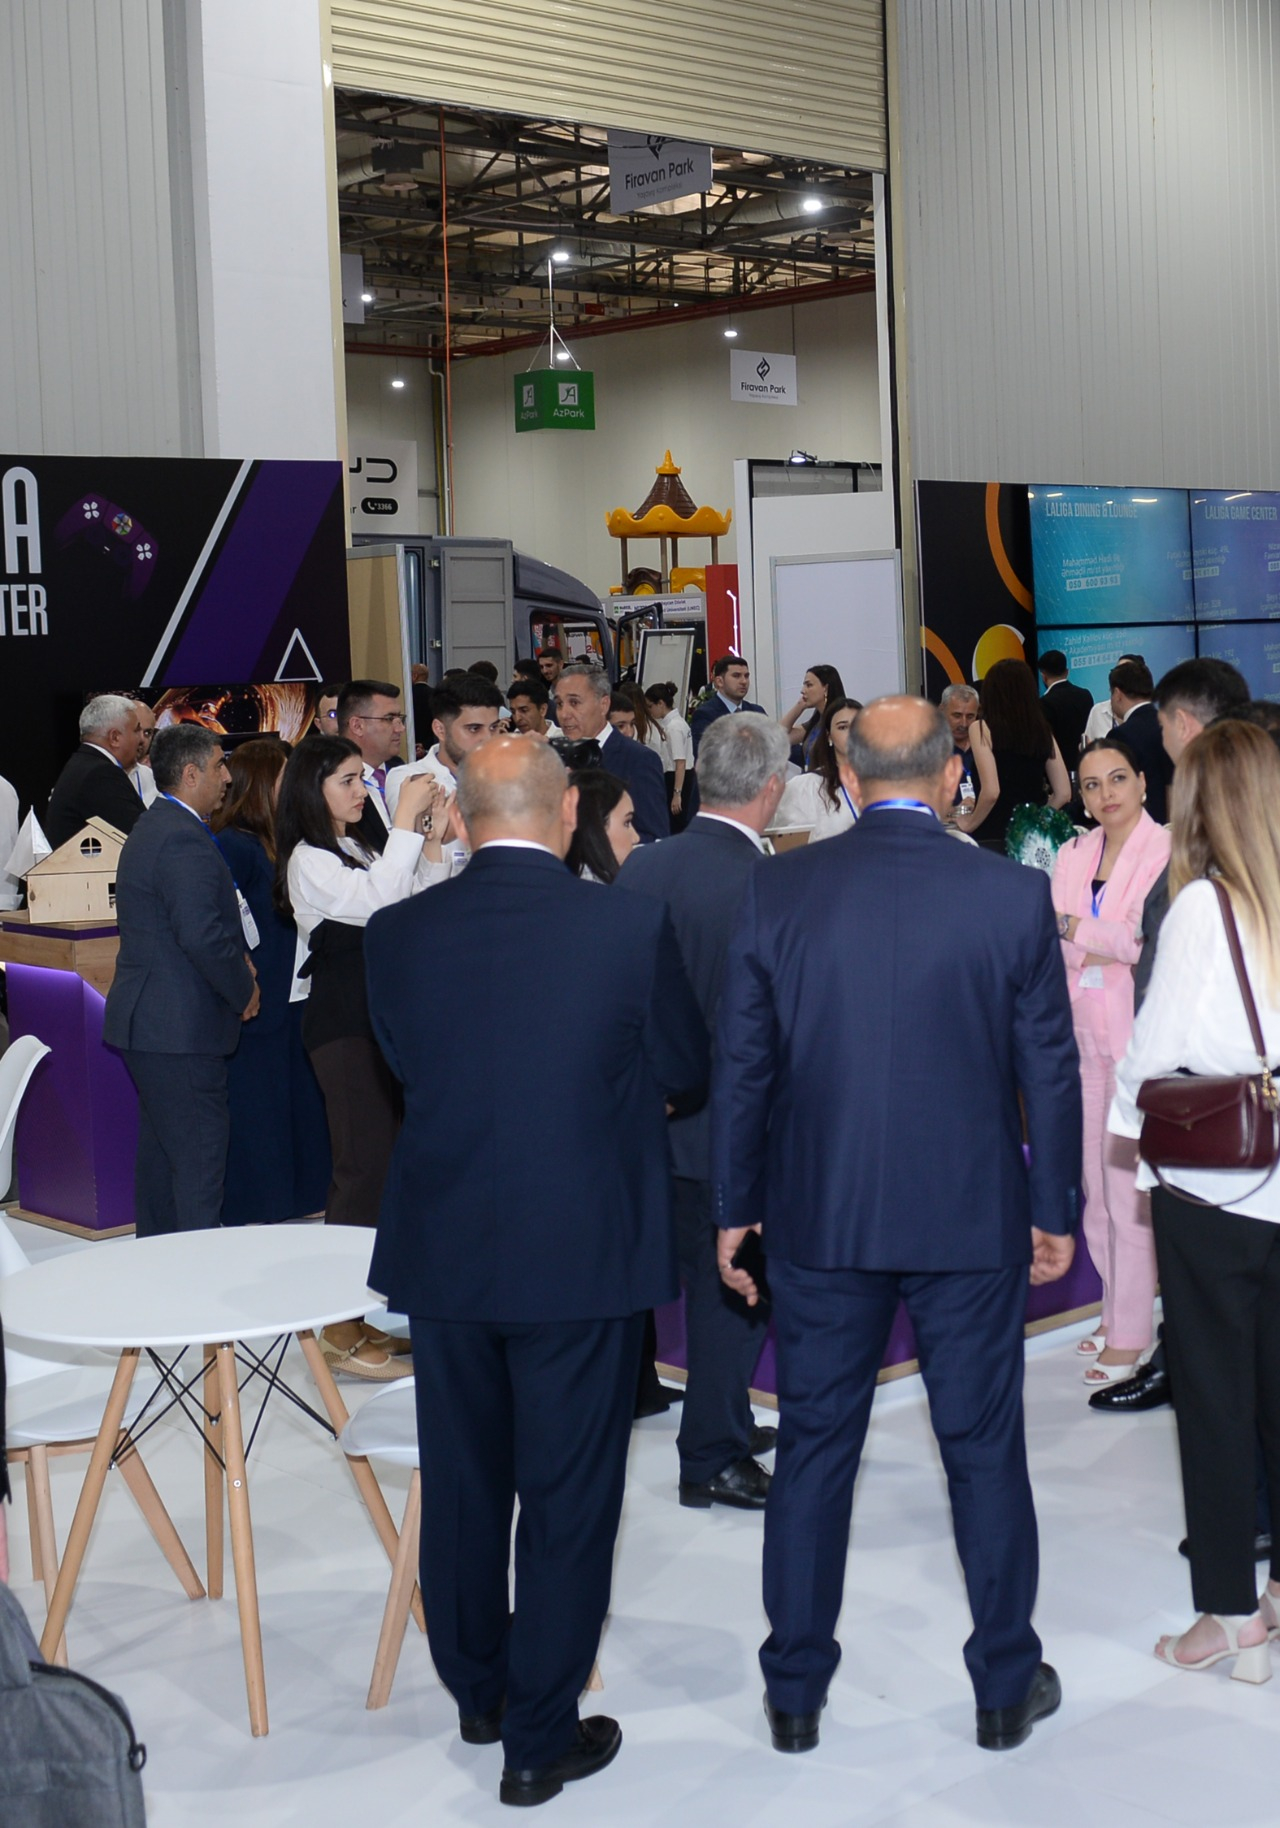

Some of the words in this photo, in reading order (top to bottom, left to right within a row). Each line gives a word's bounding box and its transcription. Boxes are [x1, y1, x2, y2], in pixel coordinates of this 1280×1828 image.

[624, 167, 666, 190] Firavan
[668, 158, 694, 178] Park
[740, 382, 769, 393] Firavan
[770, 384, 786, 394] Park
[552, 408, 585, 418] AzPark
[1230, 506, 1250, 520] GAME
[1250, 506, 1278, 520] CENTER
[0, 584, 49, 636] TER
